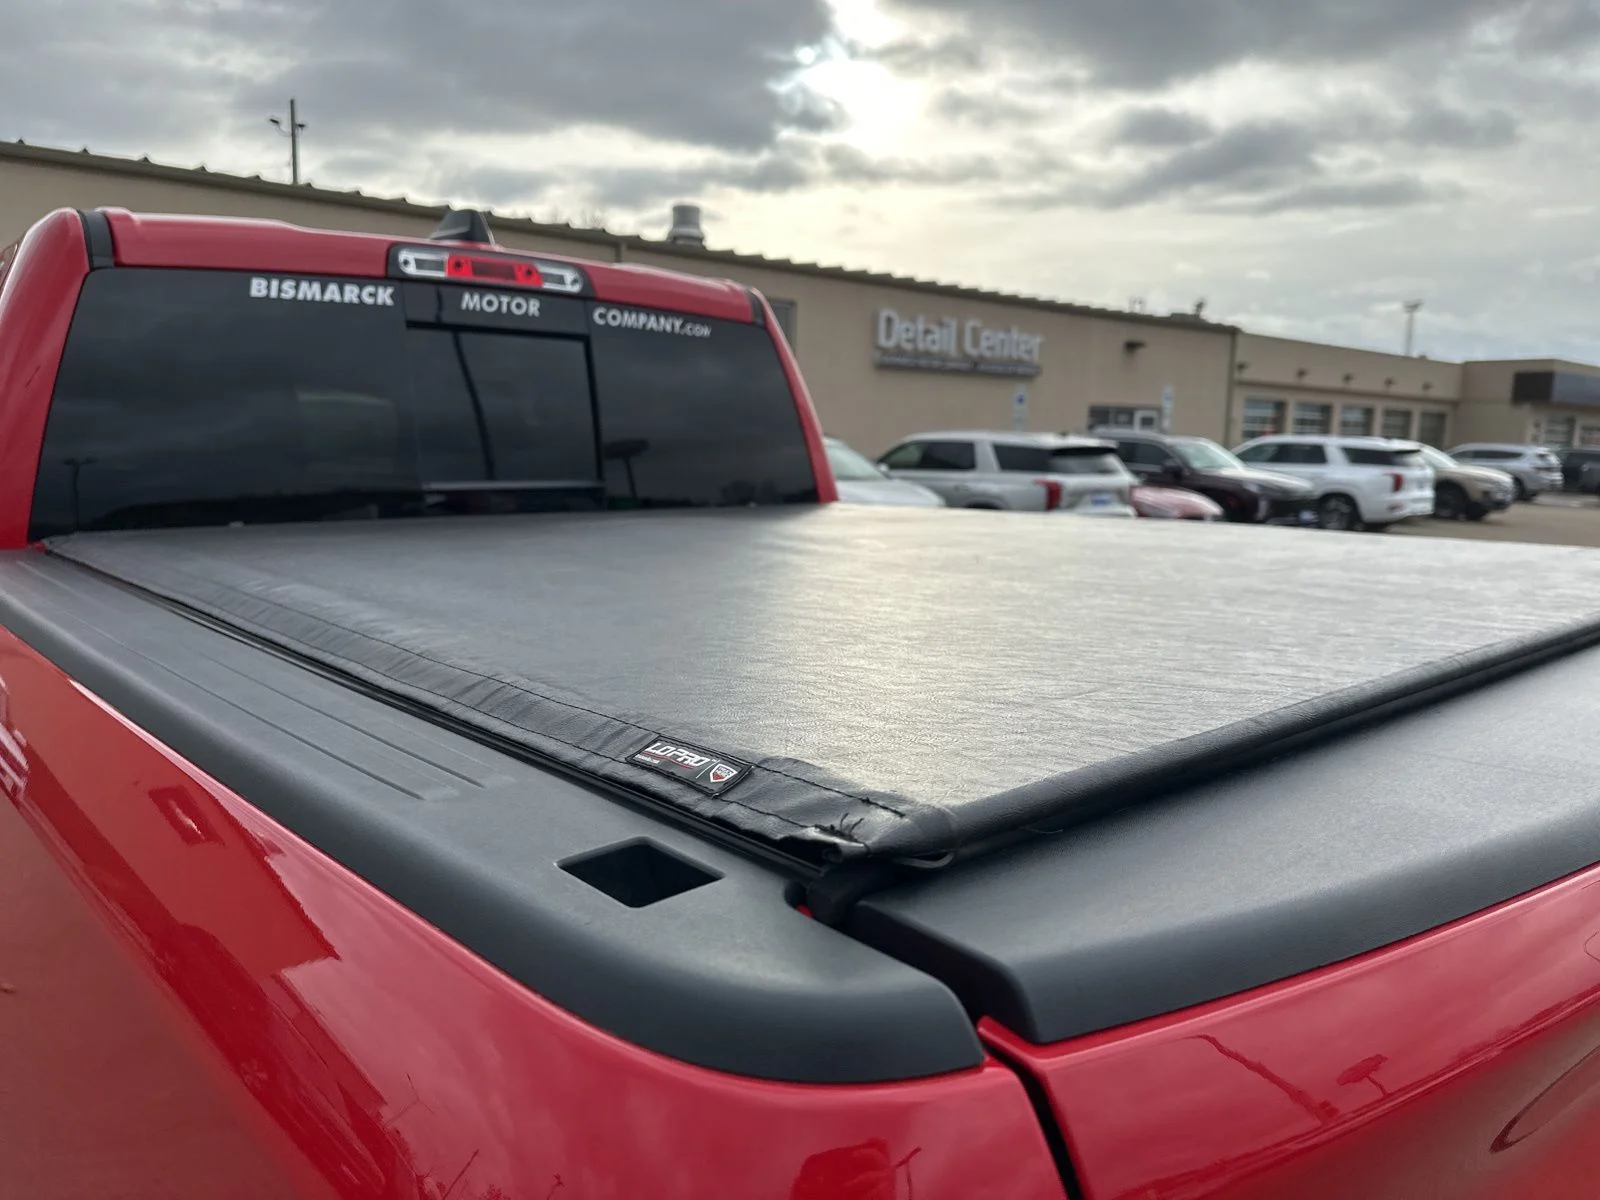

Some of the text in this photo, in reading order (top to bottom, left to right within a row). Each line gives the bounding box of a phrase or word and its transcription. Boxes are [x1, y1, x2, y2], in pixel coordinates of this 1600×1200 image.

[249, 276, 395, 306] BISMARCK
[461, 292, 541, 317] MOTOR
[876, 308, 1045, 364] Detail Center
